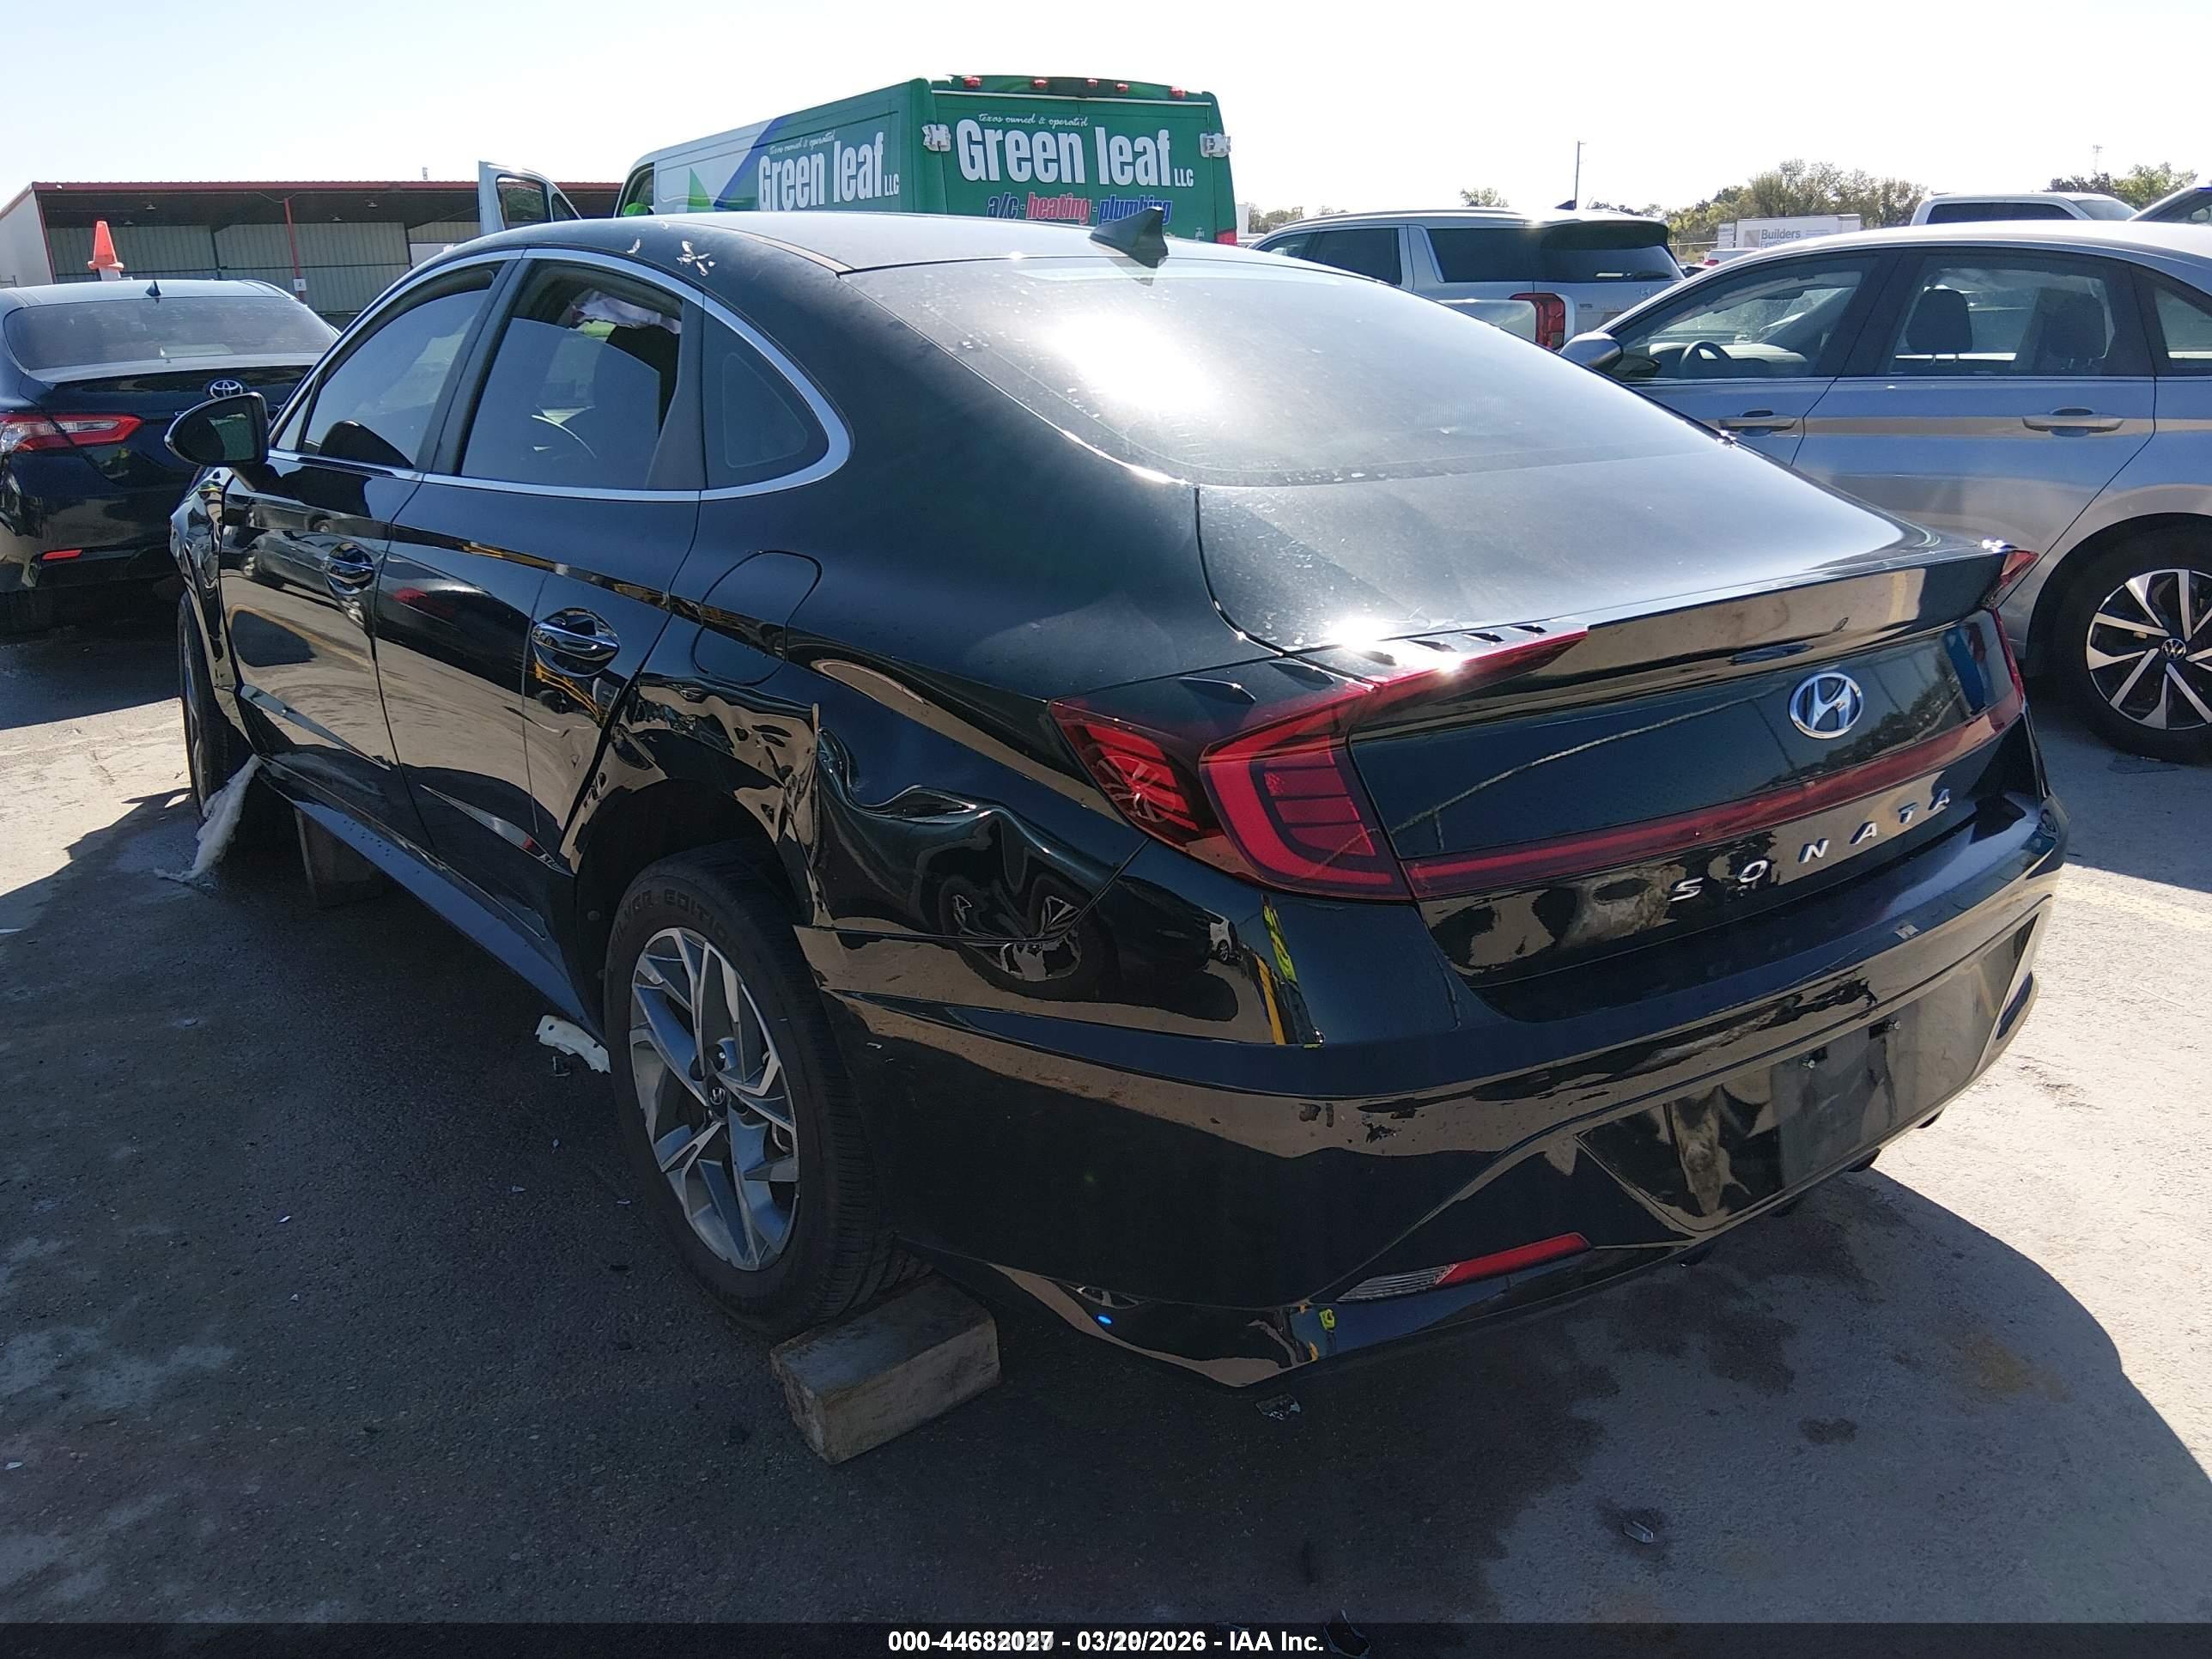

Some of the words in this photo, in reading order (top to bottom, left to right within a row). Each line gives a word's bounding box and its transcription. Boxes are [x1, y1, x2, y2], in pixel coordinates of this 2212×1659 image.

[758, 152, 825, 211] Green
[833, 131, 884, 204] leaf
[884, 173, 900, 197] LLC
[956, 118, 1086, 185] Green
[1094, 126, 1171, 187] leaf
[1174, 167, 1194, 187] LLC
[1026, 191, 1091, 226] heating
[1761, 228, 1802, 240] Builders
[1668, 788, 1951, 902] SONATA
